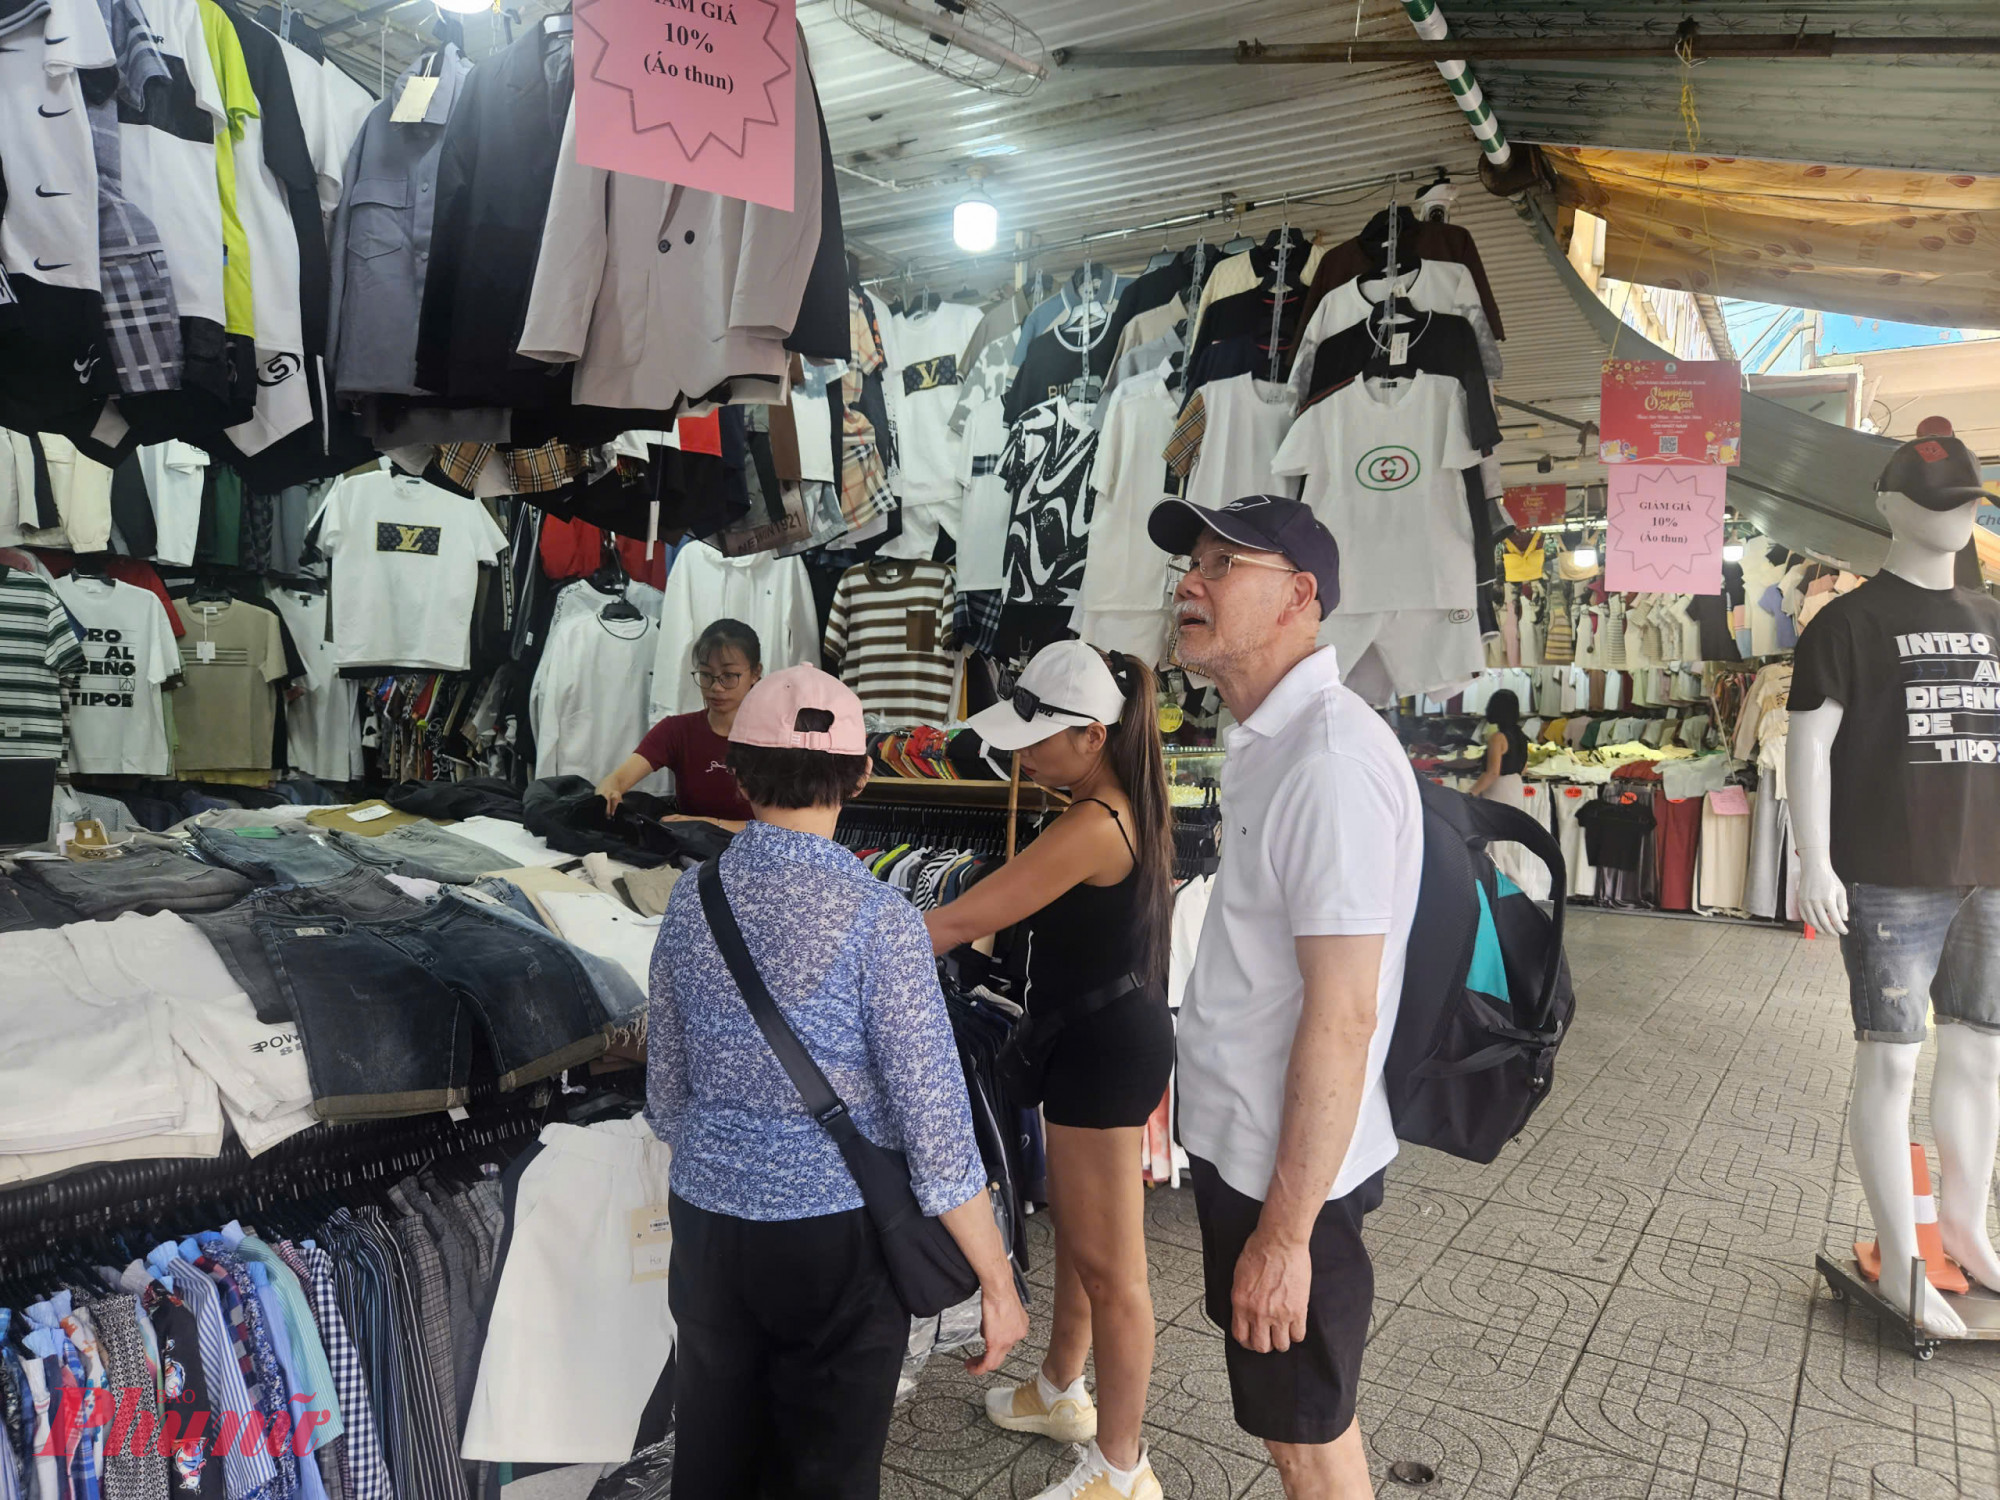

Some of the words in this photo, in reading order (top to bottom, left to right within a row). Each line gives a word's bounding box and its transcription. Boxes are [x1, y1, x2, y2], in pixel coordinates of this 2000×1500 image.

[701, 1, 738, 25] GIÁ
[664, 22, 714, 54] 10%
[643, 50, 679, 77] (Áo
[684, 65, 734, 95] thun)
[1672, 501, 1692, 512] GIÁ
[1653, 517, 1678, 528] 10%
[1976, 514, 2000, 526] Ch
[1639, 531, 1658, 544] (Áo
[1661, 533, 1688, 544] thun)
[104, 645, 135, 660] AL
[1895, 632, 1991, 657] INTRO
[69, 692, 134, 708] TIPOS
[1905, 682, 2000, 710] DISEÑ
[1934, 738, 2000, 764] TIPO
